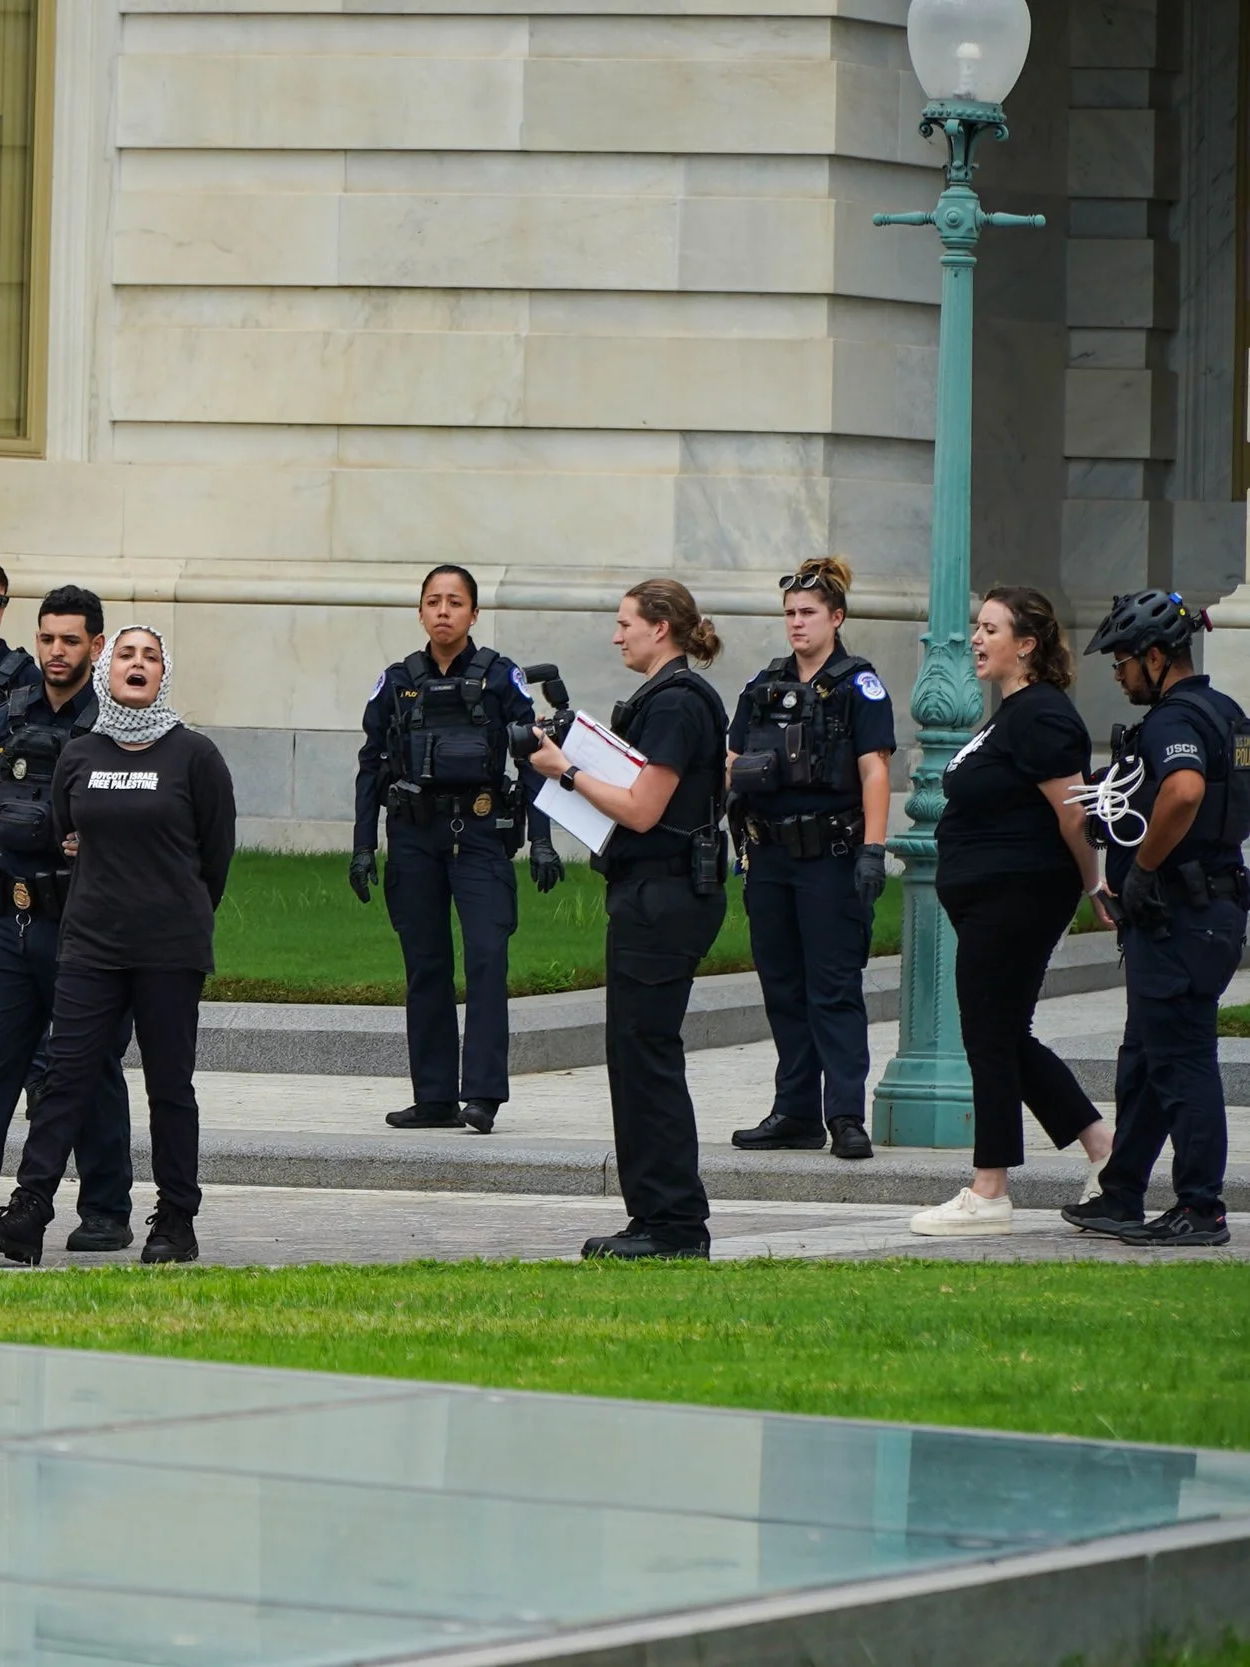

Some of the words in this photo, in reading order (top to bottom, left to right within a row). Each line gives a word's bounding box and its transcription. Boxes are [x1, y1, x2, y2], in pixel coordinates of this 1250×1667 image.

[1165, 743, 1198, 756] USCP
[91, 771, 129, 780] BOYCOTT
[129, 771, 158, 781] ISRAEL
[87, 779, 110, 789] FREE
[110, 779, 158, 790] PALESTINE
